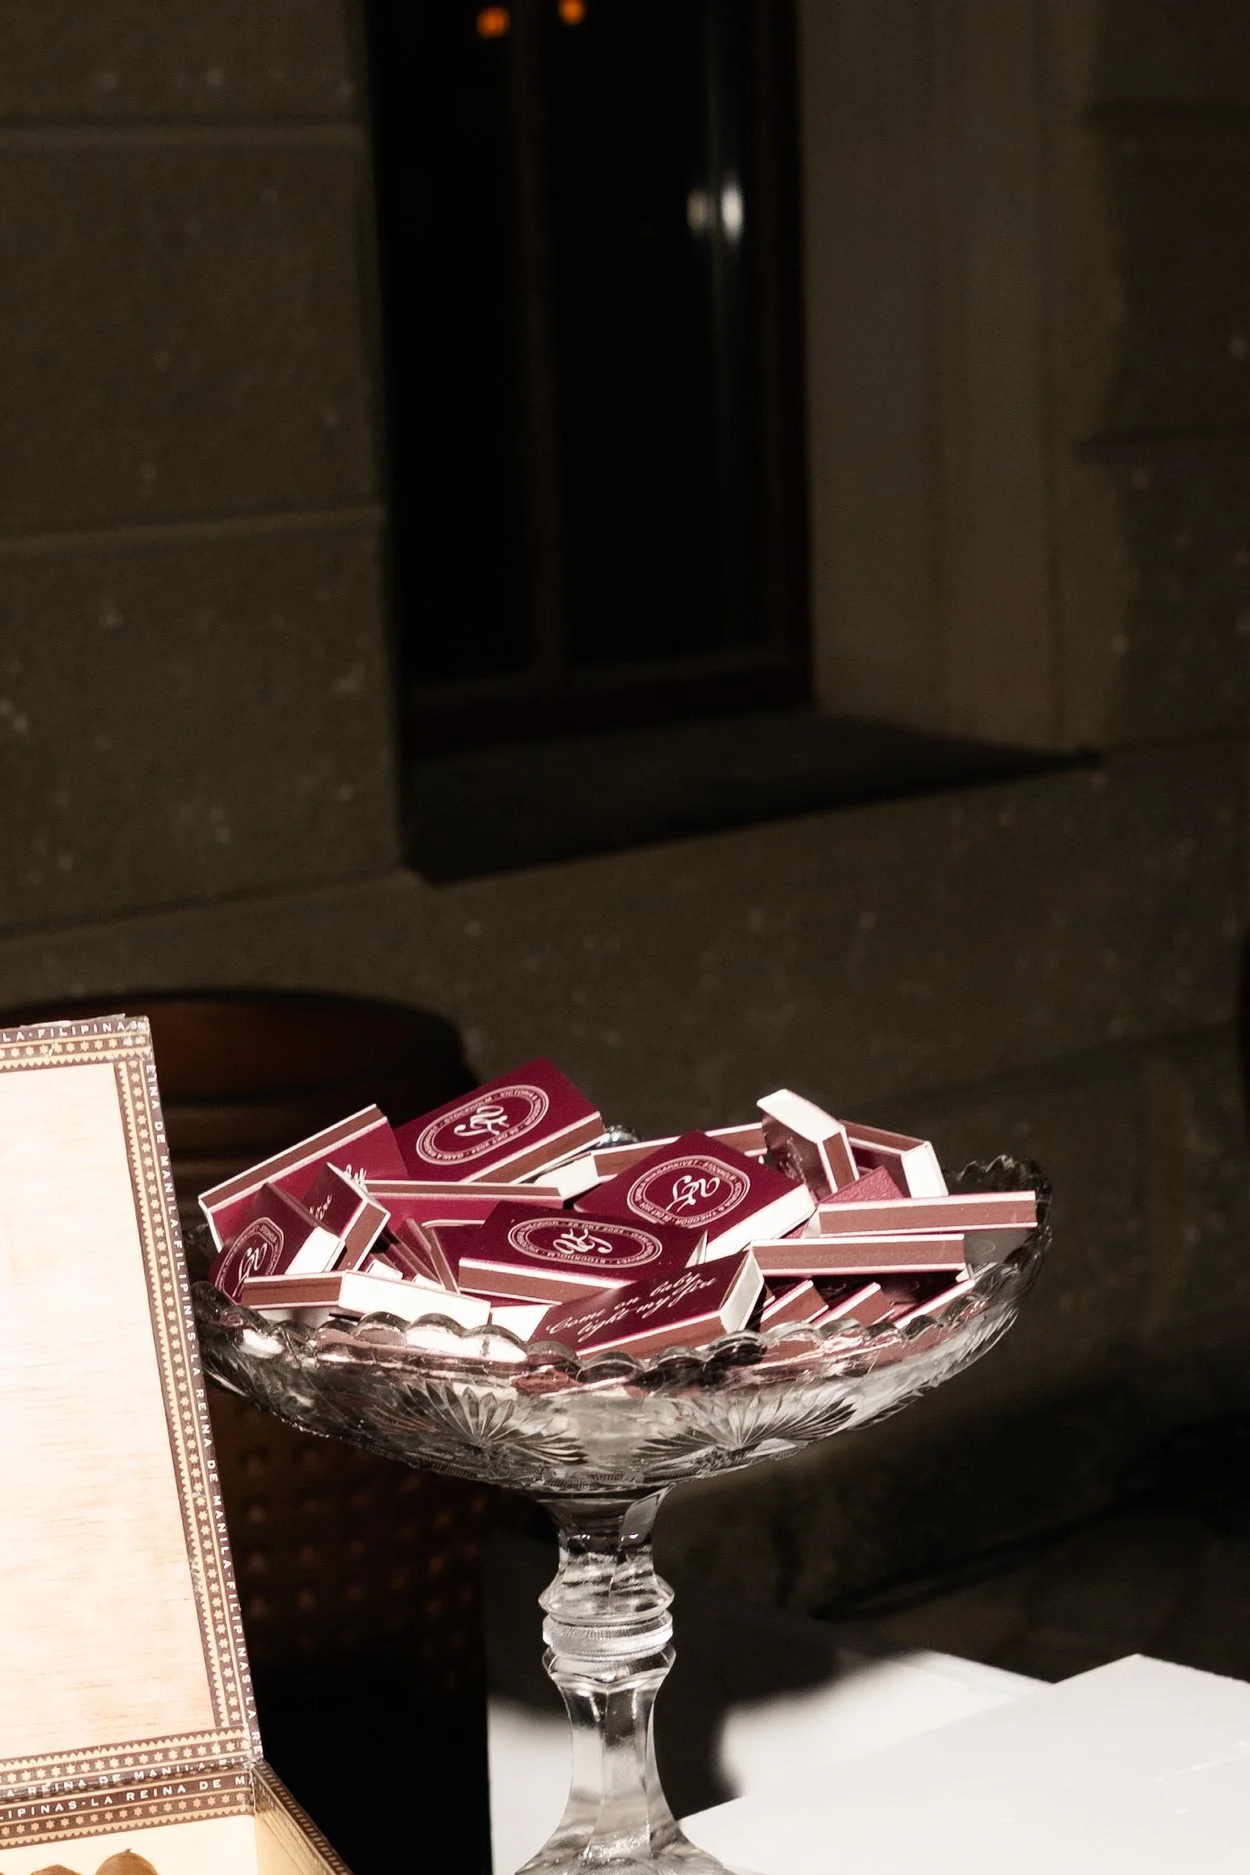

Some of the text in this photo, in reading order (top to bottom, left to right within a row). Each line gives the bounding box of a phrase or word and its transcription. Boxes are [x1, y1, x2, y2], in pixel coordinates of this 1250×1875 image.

[152, 1120, 165, 1144] DE
[194, 1387, 212, 1448] REINA
[205, 1459, 218, 1483] DE
[545, 1271, 702, 1335] Come on baby
[577, 1277, 718, 1343] light my fire
[26, 1777, 88, 1795] REINA
[97, 1773, 122, 1785] DE
[125, 1783, 187, 1801] REINA
[198, 1778, 222, 1790] DE
